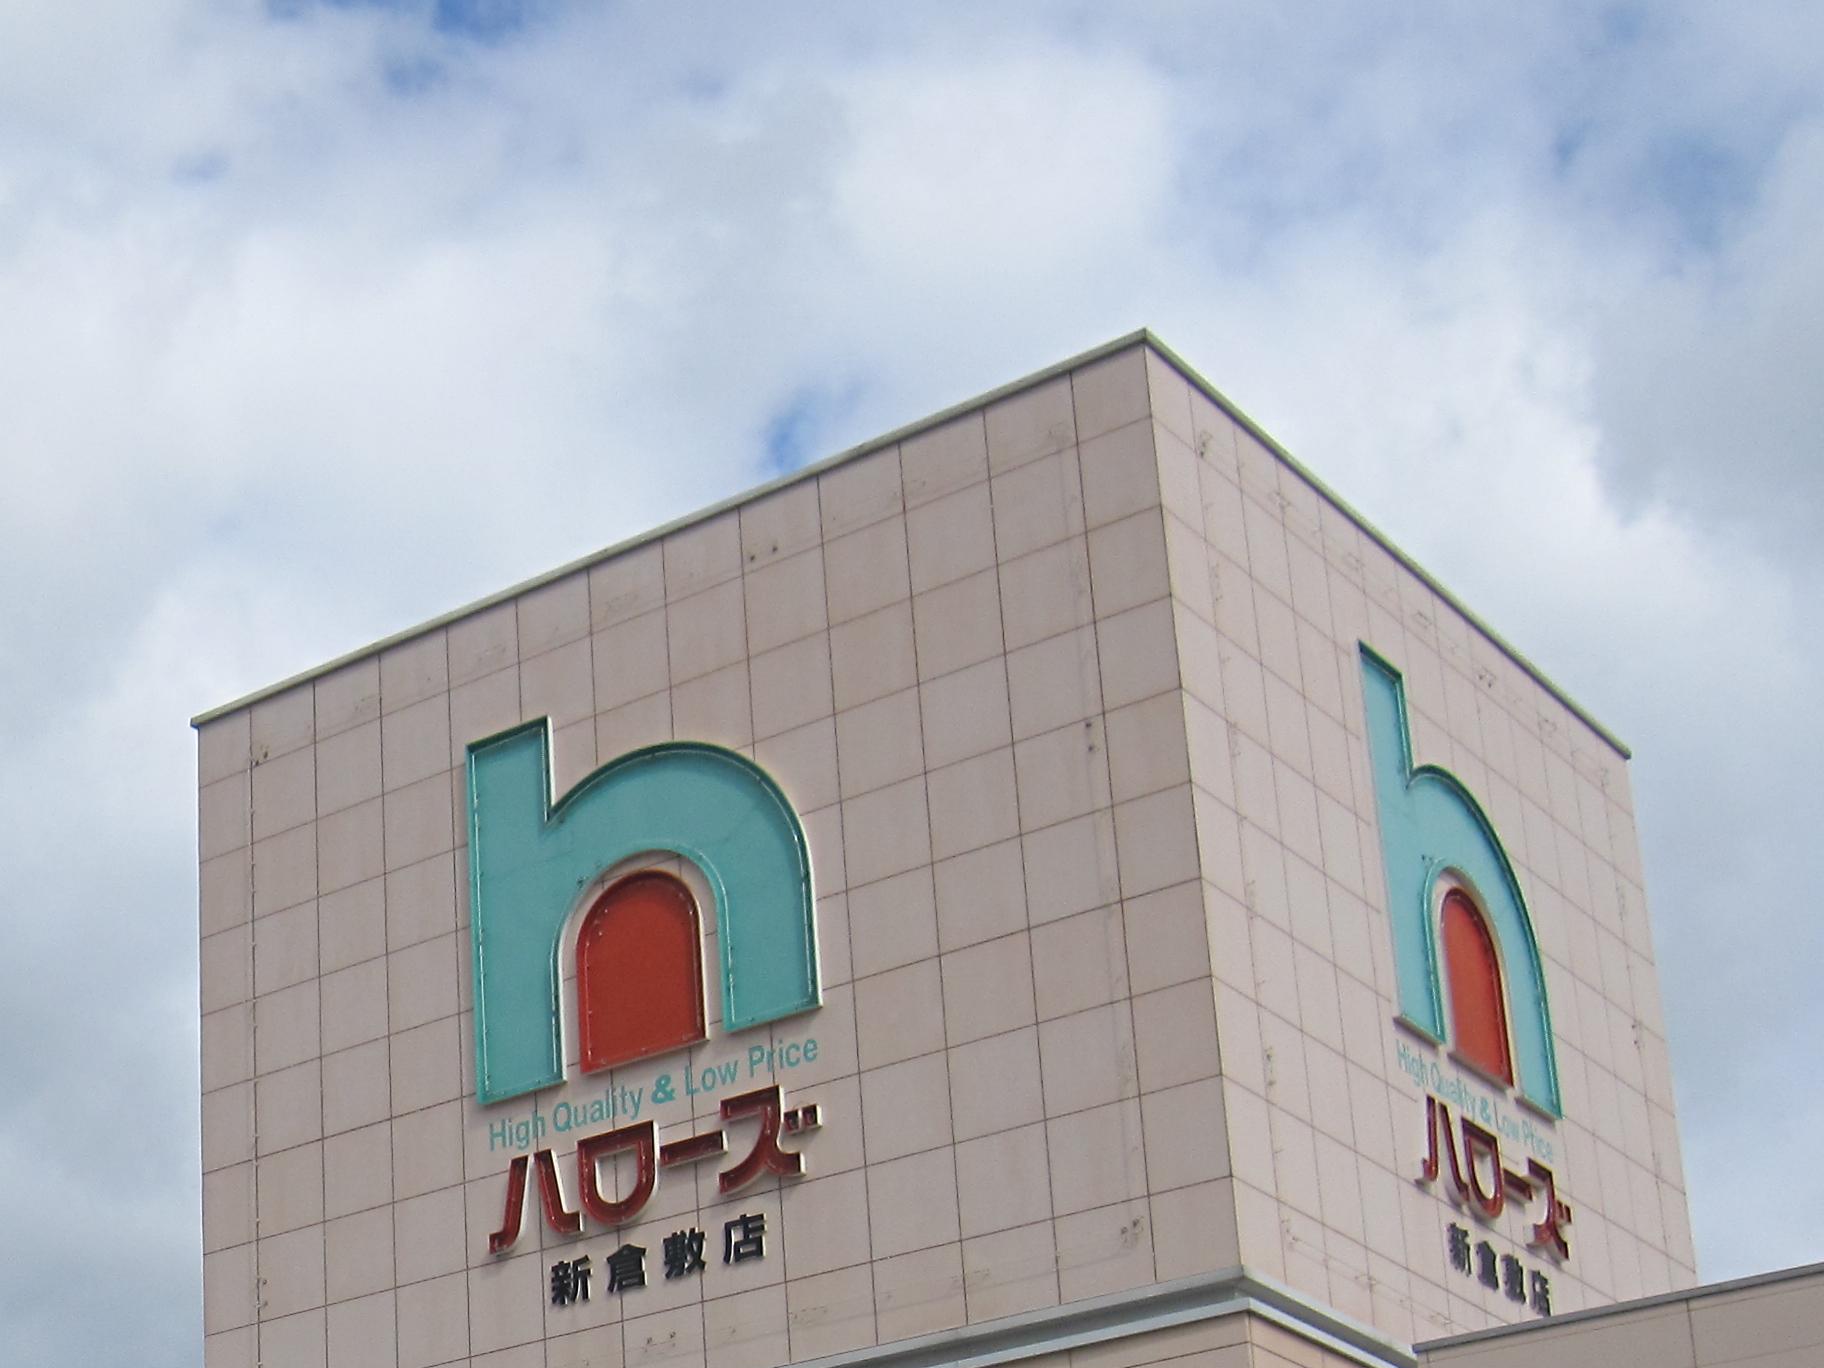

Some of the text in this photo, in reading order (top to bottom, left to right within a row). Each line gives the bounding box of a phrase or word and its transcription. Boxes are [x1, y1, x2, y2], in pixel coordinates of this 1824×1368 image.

[489, 1038, 819, 1151] High Quality & Low Price
[1396, 1040, 1429, 1089] High
[1429, 1061, 1477, 1117] Quality
[489, 1085, 823, 1256] ハローズ
[1416, 1095, 1572, 1260] ハローズ
[551, 1213, 767, 1306] 新倉敷店
[1446, 1222, 1551, 1317] 新倉敷店
